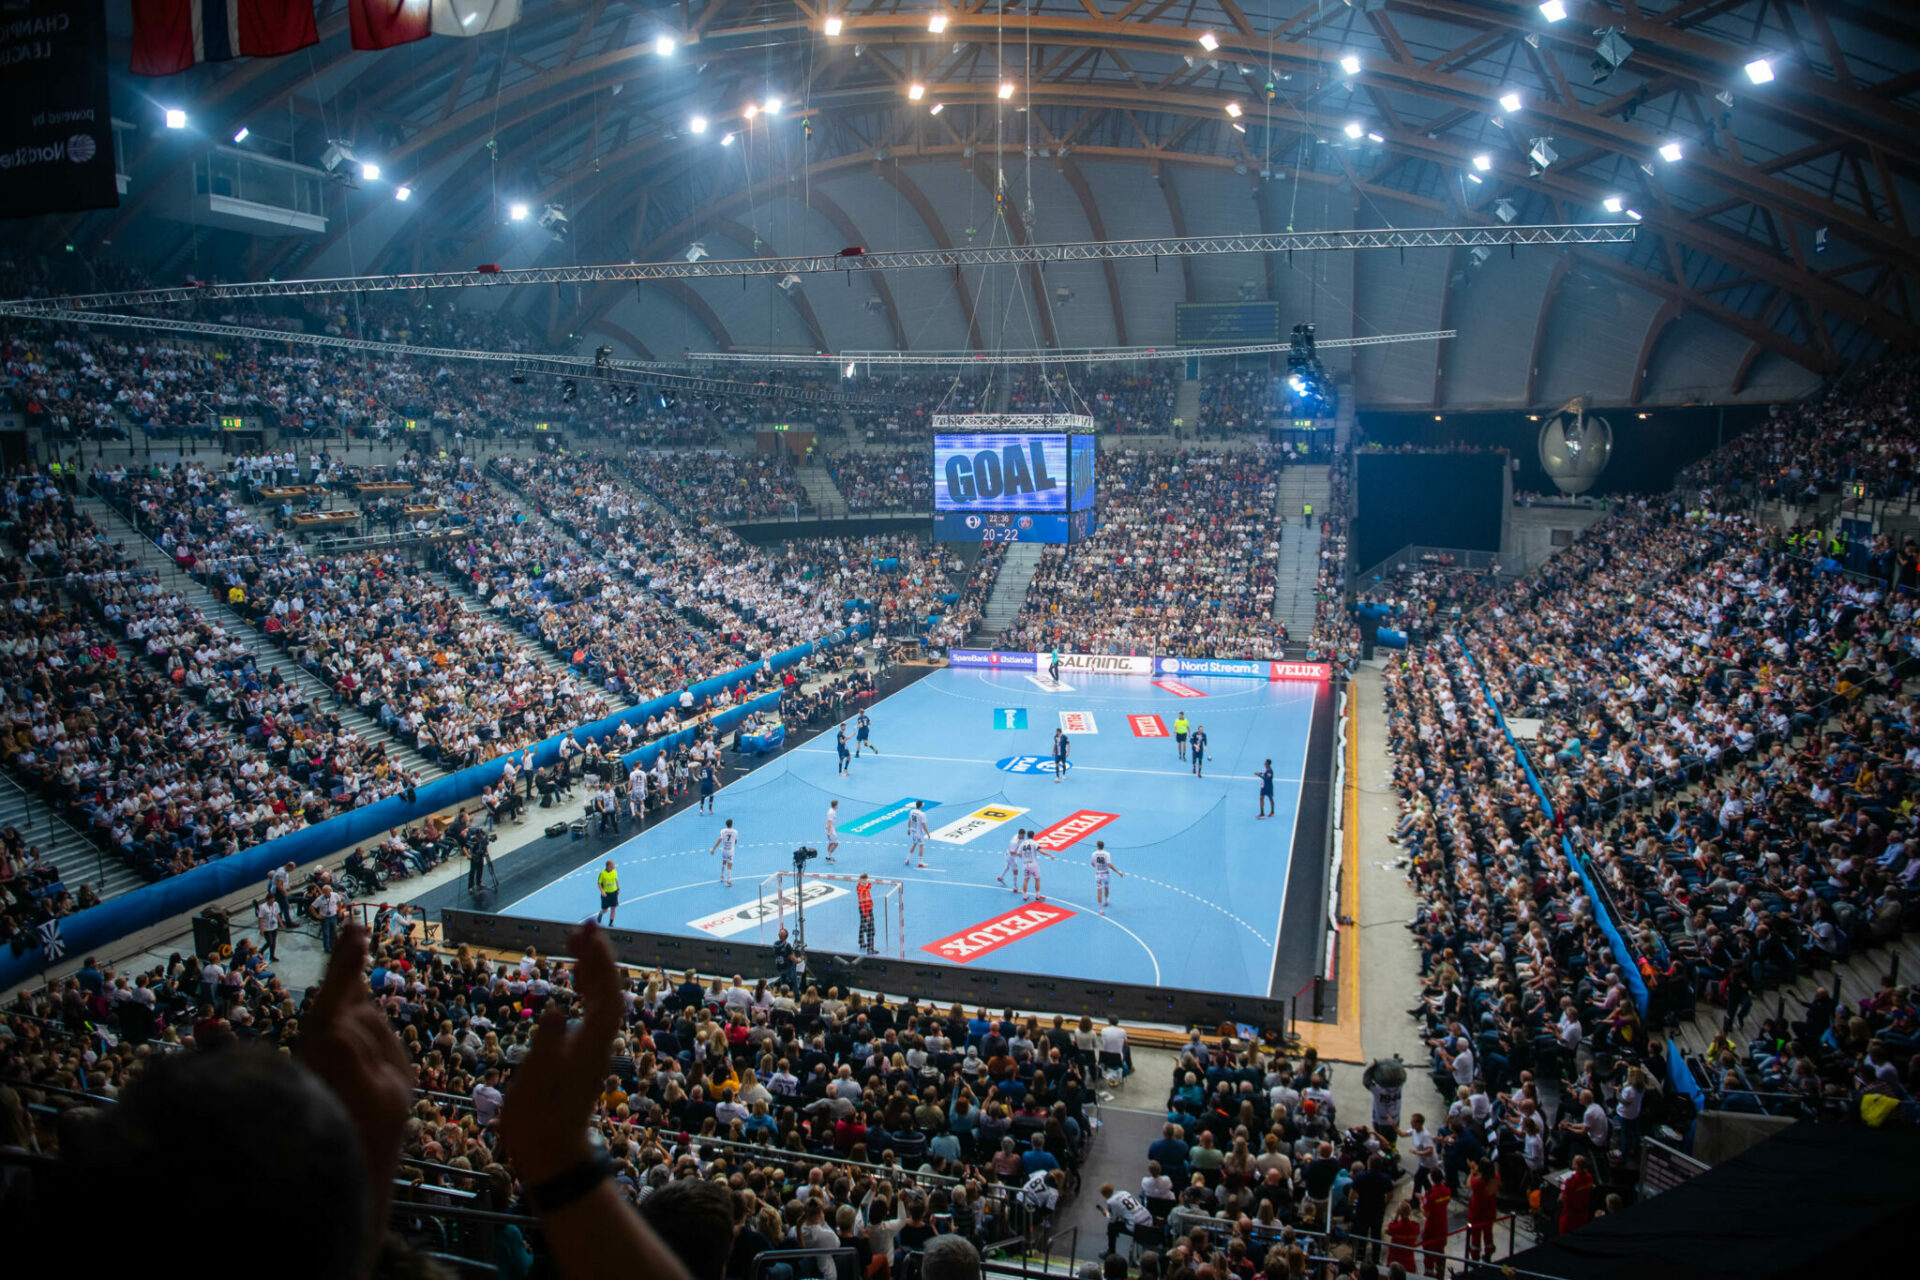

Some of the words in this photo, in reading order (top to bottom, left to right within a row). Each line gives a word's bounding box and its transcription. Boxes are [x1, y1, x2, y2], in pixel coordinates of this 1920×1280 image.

[945, 441, 1057, 504] GOAL
[952, 653, 988, 663] SpareBank
[1000, 655, 1034, 664] Østlandet
[1181, 661, 1209, 672] Nord
[1210, 662, 1250, 673] Stream
[1250, 664, 1260, 674] 2
[1275, 664, 1321, 676] VELUX
[1048, 814, 1109, 848] VELUX
[940, 909, 1060, 957] VELUX
[1030, 1178, 1046, 1193] 87
